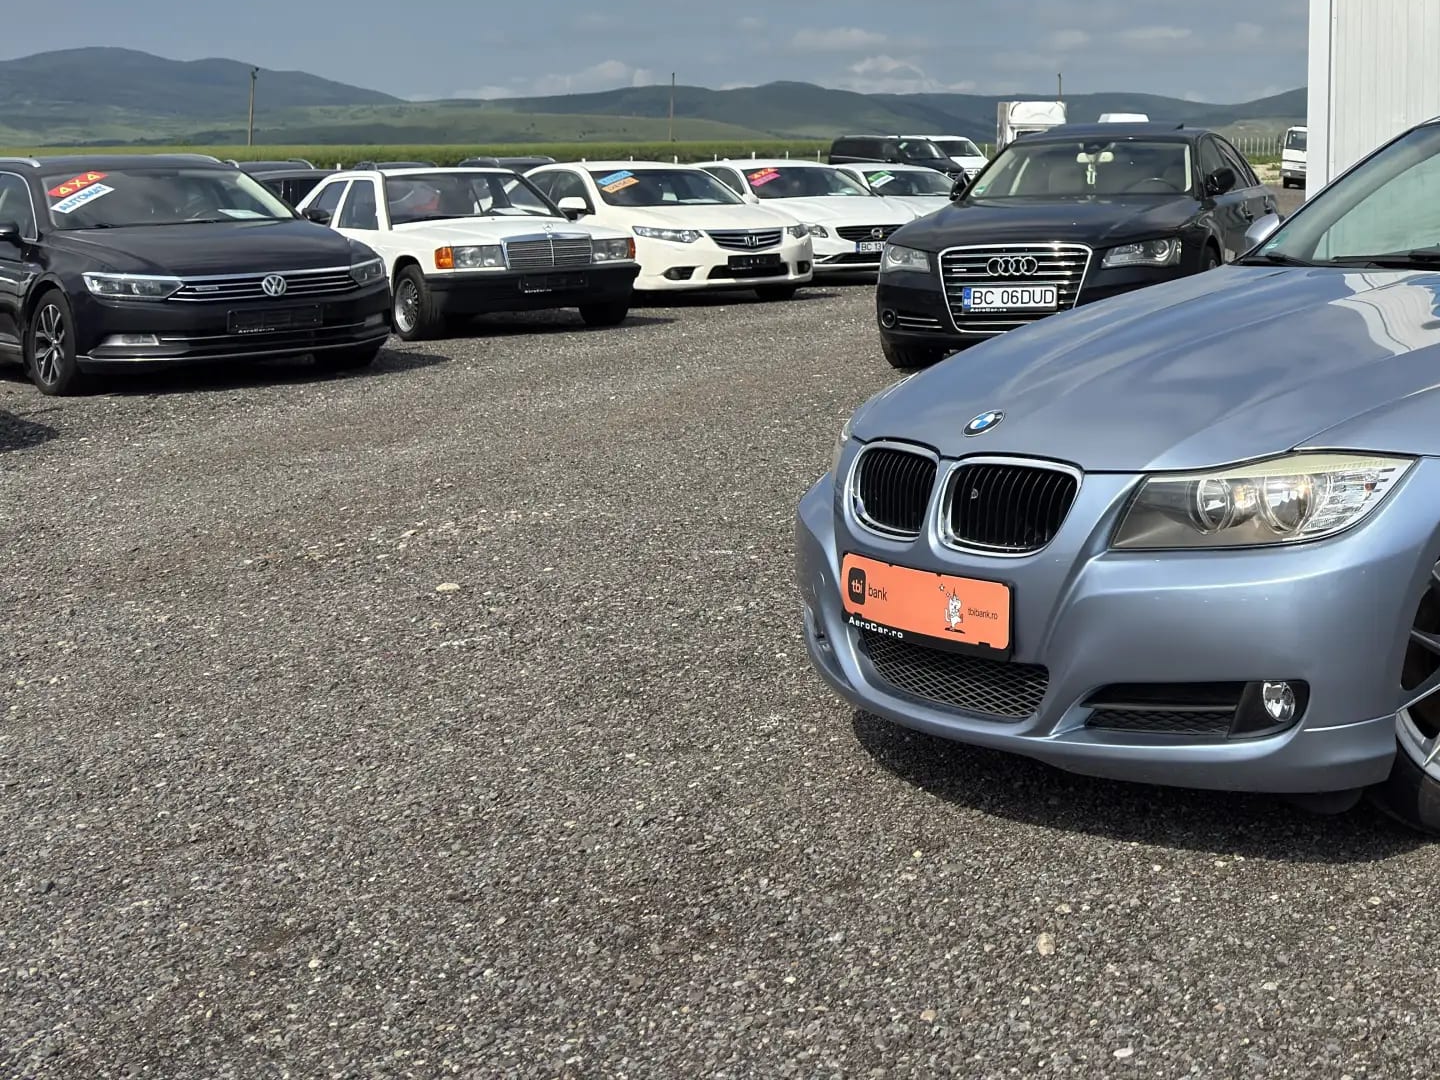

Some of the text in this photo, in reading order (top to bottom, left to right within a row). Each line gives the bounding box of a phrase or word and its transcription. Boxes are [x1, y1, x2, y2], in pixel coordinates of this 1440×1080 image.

[59, 185, 107, 211] AUTOMAT
[861, 242, 871, 251] BC
[972, 290, 994, 305] BC
[1001, 289, 1055, 305] 06DUD
[851, 579, 888, 602] tbi bank
[967, 607, 999, 620] tbibank.ro
[848, 615, 904, 639] AeroCar.ro
